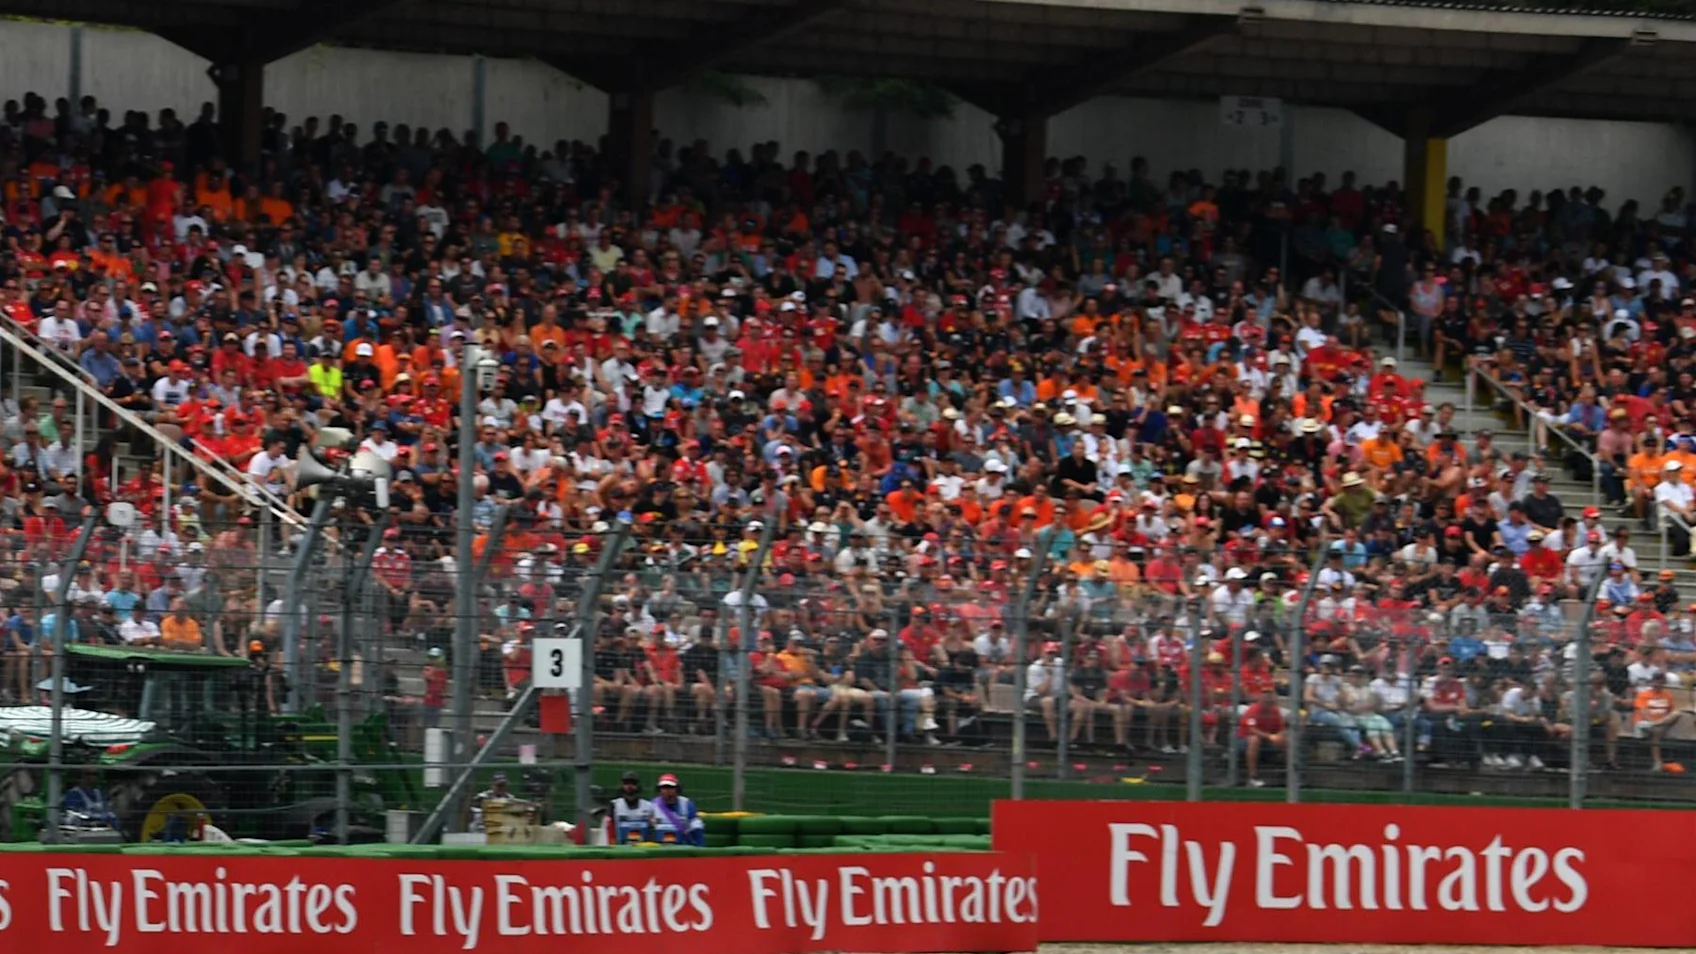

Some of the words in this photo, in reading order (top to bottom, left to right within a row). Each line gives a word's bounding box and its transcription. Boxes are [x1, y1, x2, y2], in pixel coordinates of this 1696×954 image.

[550, 648, 563, 678] 3
[46, 867, 123, 948] Fly
[131, 866, 358, 935] Emirates
[398, 872, 484, 951] Fly
[494, 869, 714, 935] Emirates
[747, 867, 829, 942] Fly
[1108, 822, 1236, 927] Fly
[1254, 822, 1589, 914] Emirates
